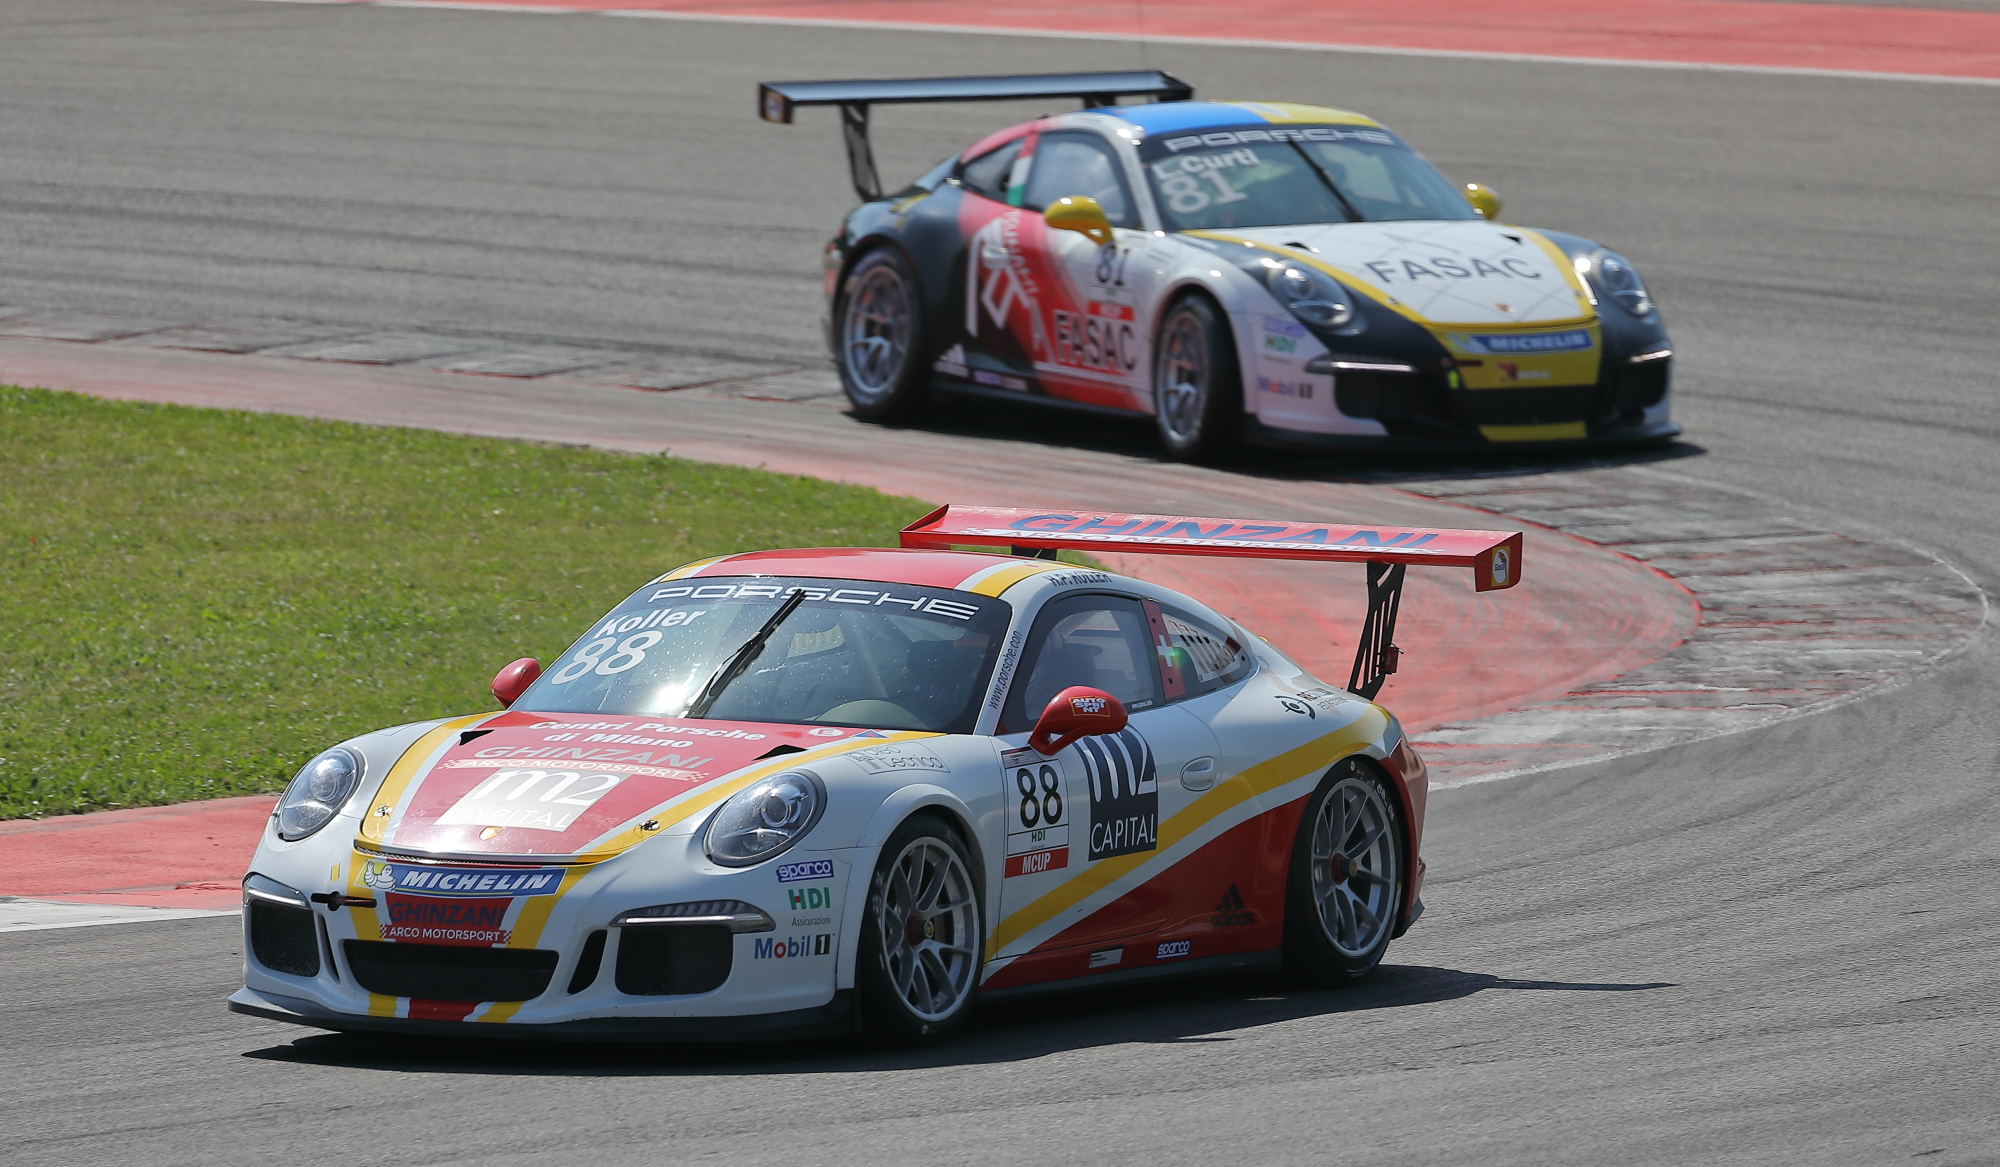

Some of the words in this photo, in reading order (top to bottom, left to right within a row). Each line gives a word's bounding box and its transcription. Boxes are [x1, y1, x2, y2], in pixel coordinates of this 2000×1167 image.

[1164, 128, 1394, 152] PORSCHE
[1151, 148, 1260, 181] L.Curti
[1160, 170, 1247, 214] 81
[1096, 242, 1130, 287] 81
[1363, 256, 1542, 283] FASAC
[1055, 310, 1137, 372] FASAC
[1489, 332, 1587, 350] MICHELIN
[1257, 375, 1295, 396] Mobil
[1009, 513, 1440, 548] GHINZANI
[996, 531, 1111, 541] ARCO
[1120, 536, 1402, 554] MOTORSPORT
[647, 584, 980, 621] PORSCHE
[595, 607, 706, 639] Koller
[551, 630, 663, 686] 88
[528, 721, 632, 733] Centri
[634, 721, 767, 742] Porsche
[542, 733, 573, 742] di
[580, 733, 694, 749] Milano
[462, 760, 526, 769] ARCO
[530, 760, 690, 778] MOTORSPORT
[474, 746, 714, 770] GHINZANI
[472, 769, 621, 807] m2
[1016, 764, 1063, 829] 88
[443, 806, 572, 829] CAPITAL
[1031, 830, 1046, 843] HDI
[1091, 814, 1157, 853] CAPITAL
[779, 861, 831, 881] sparco
[1022, 852, 1051, 875] MCUP
[400, 870, 553, 891] MICHELIN
[788, 887, 831, 910] HDI
[389, 901, 505, 927] GHINZANI
[791, 915, 832, 927] Assicurazioni
[1212, 909, 1255, 927] adidas
[389, 926, 420, 939] ARCO
[422, 929, 500, 942] MOTORSPORT
[754, 935, 811, 960] Mobil
[1157, 940, 1190, 958] sparco
